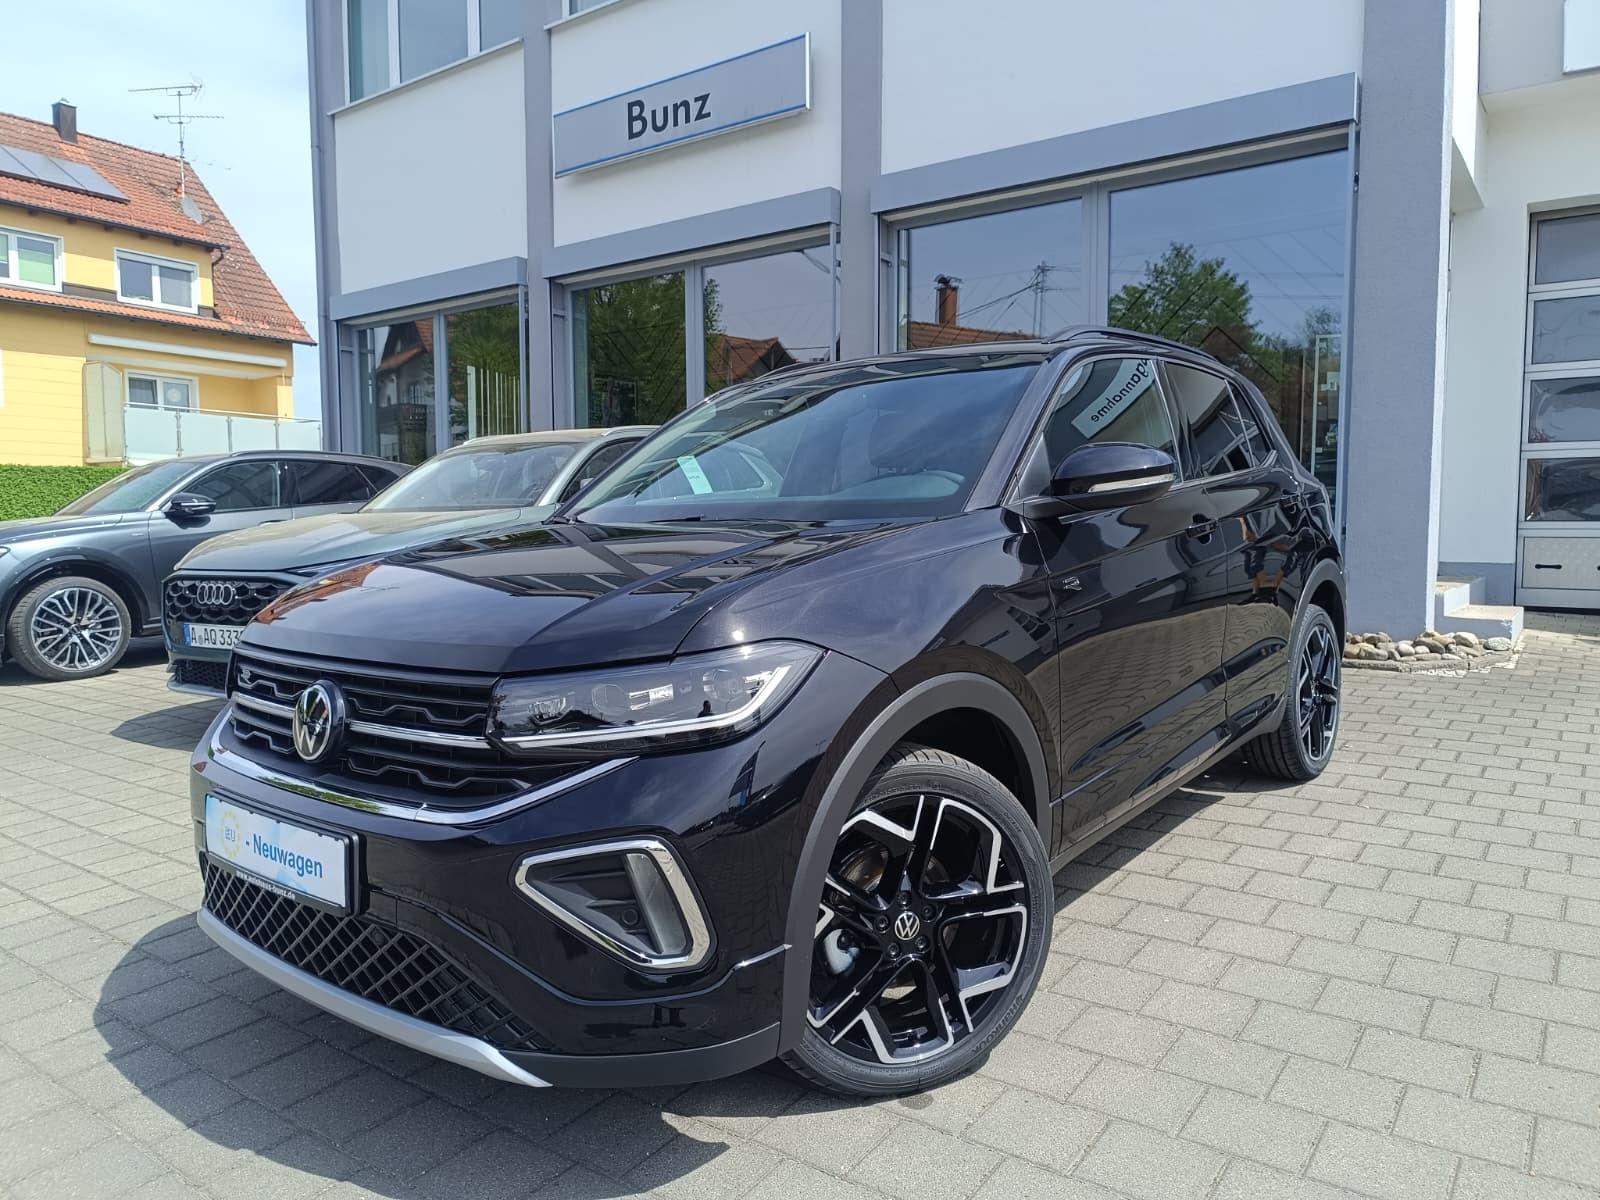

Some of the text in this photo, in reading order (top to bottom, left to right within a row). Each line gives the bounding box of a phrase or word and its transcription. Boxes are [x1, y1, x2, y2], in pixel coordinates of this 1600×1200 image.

[627, 92, 711, 140] Bunz
[218, 629, 244, 647] 333
[224, 826, 236, 842] EU
[252, 832, 323, 879] Neuwagen
